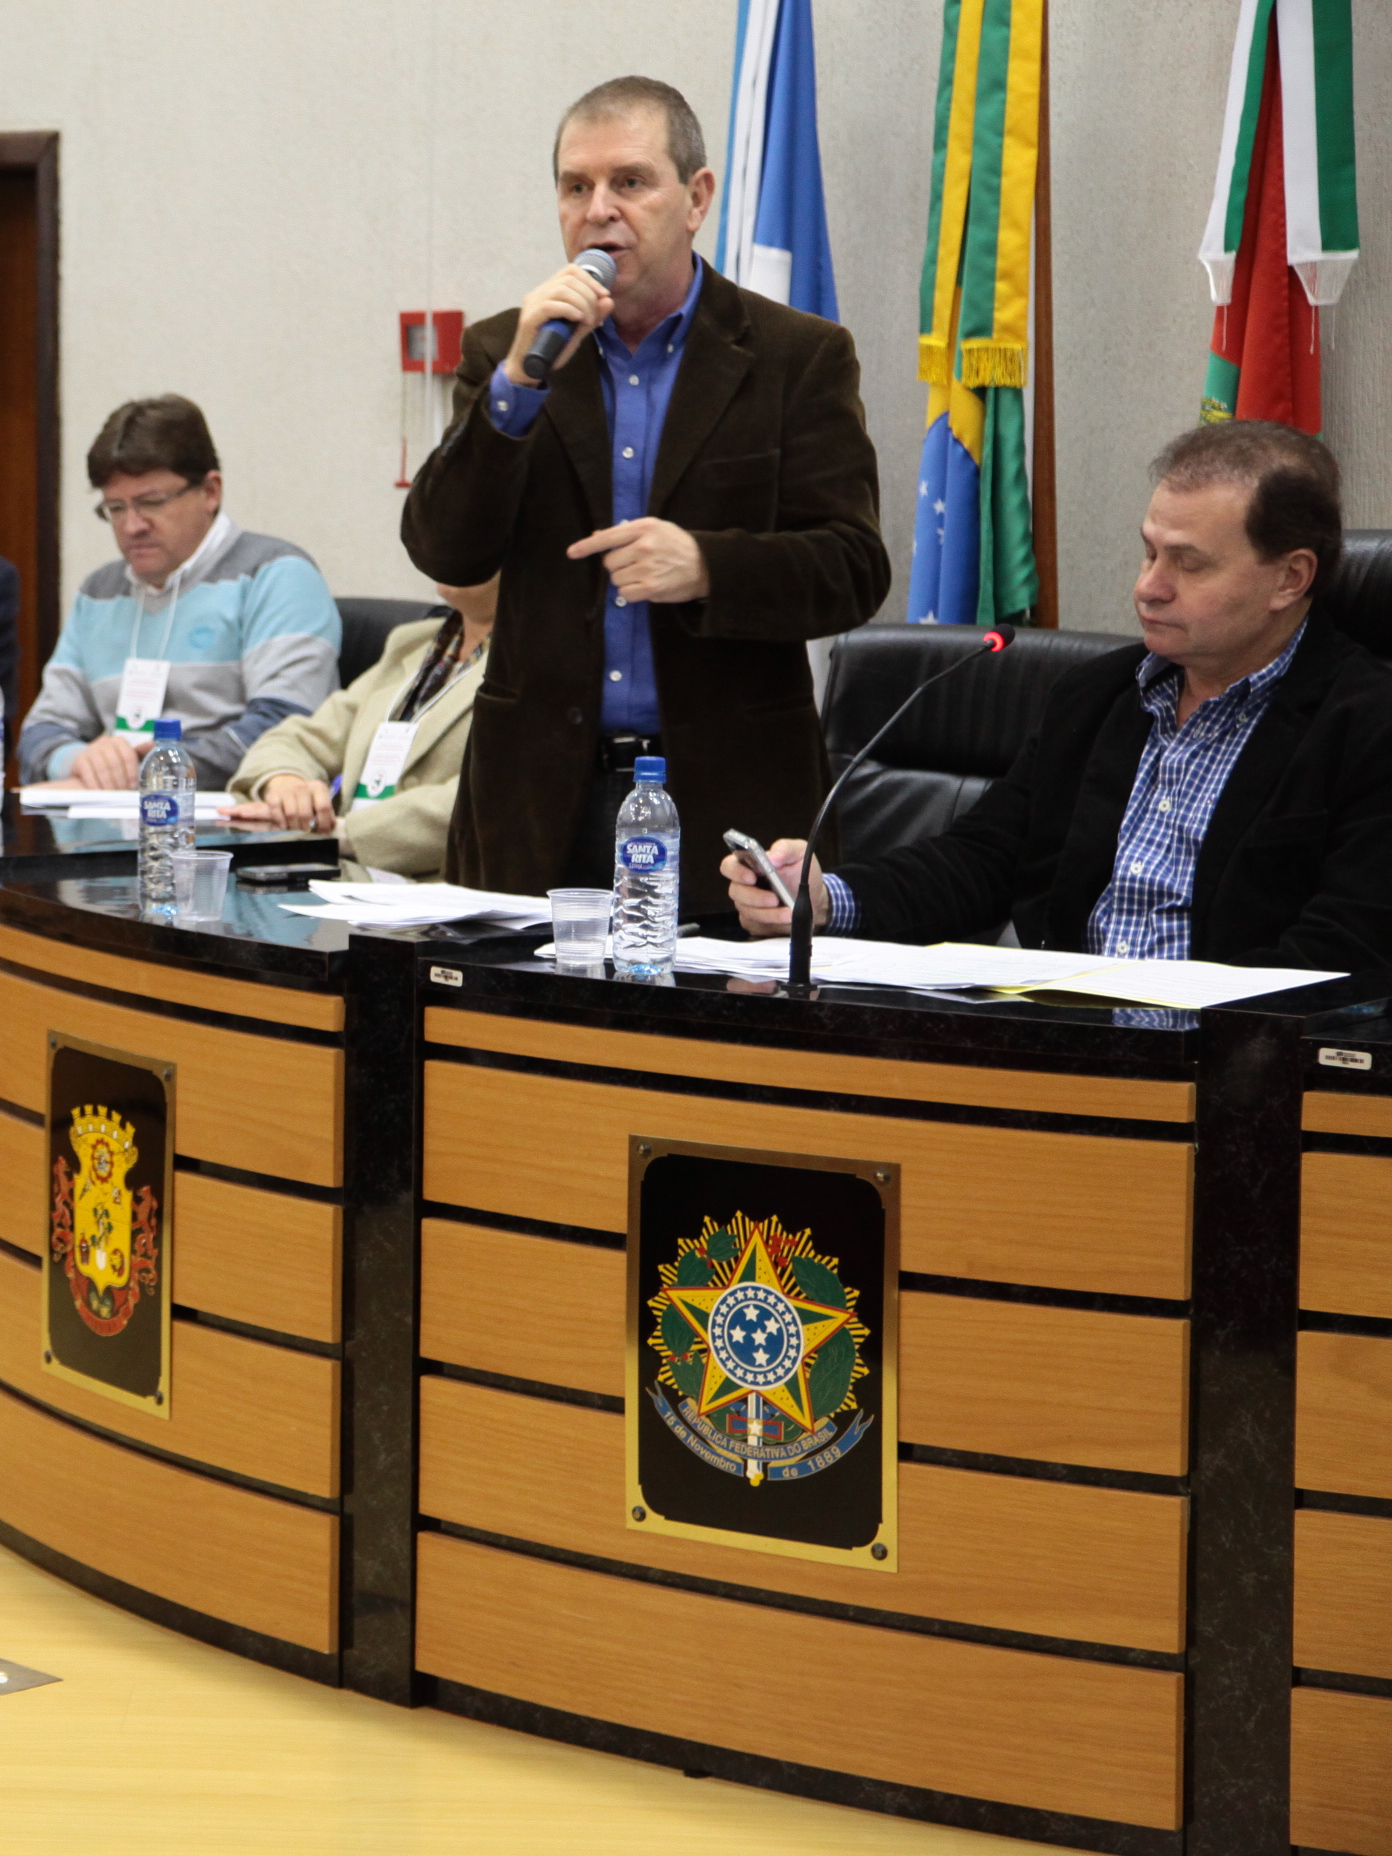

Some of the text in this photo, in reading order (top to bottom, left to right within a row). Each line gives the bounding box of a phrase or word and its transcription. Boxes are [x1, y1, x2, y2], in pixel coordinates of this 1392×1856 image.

[626, 842, 659, 855] SANTA
[631, 853, 655, 864] RITA
[663, 1411, 841, 1478] 15 de Novembro de 1889
[728, 1440, 788, 1459] FEDERATIVA
[787, 1443, 801, 1456] DO
[801, 1428, 835, 1449] BRASIL
